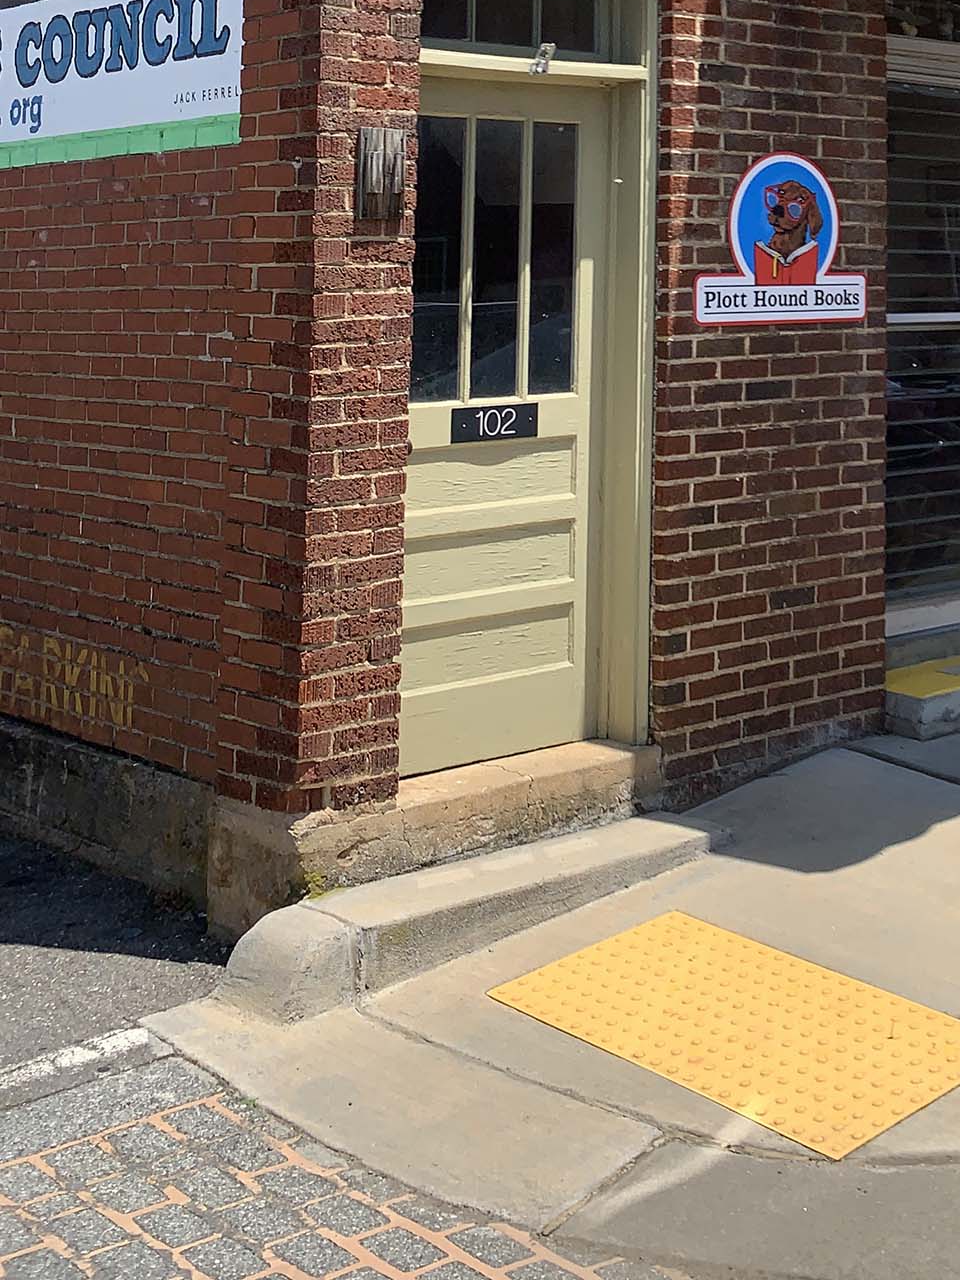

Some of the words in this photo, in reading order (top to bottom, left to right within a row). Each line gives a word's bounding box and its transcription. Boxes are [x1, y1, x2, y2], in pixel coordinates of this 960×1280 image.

[173, 91, 196, 104] JACK
[704, 291, 747, 308] Plott
[753, 289, 808, 307] Hound
[813, 288, 860, 306] Books
[475, 408, 516, 437] 102
